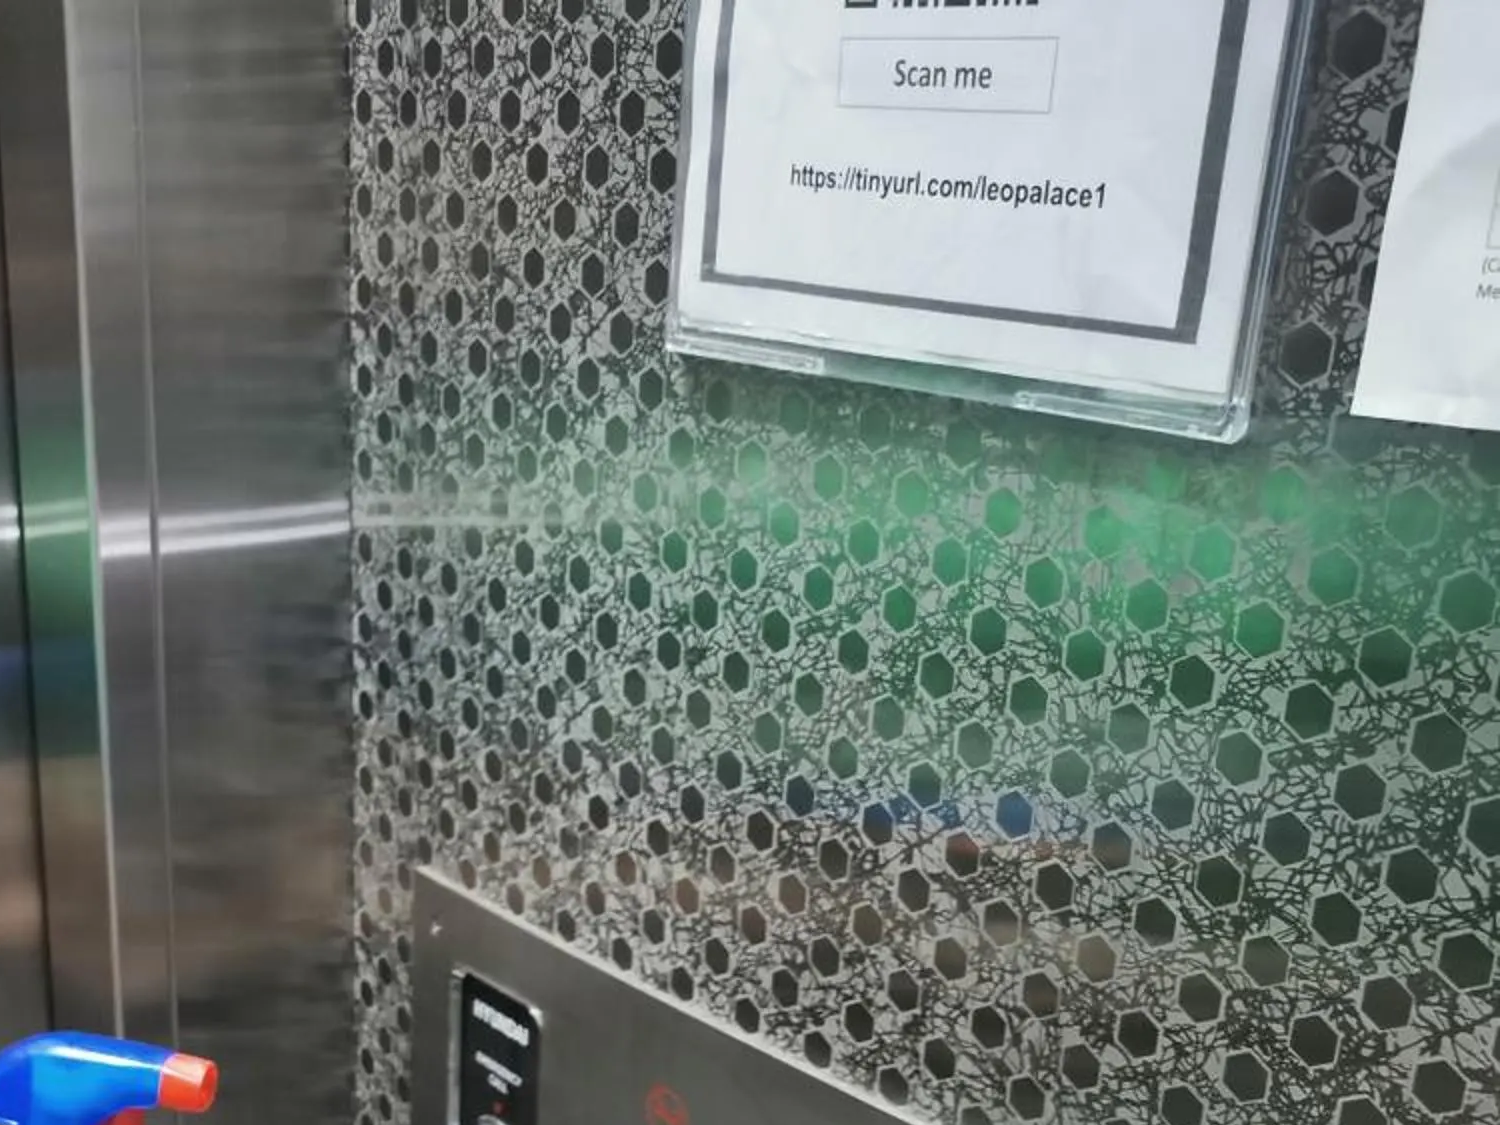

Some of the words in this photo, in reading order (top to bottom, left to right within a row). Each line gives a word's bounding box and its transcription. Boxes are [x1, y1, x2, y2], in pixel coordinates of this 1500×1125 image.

[893, 59, 947, 89] Scan
[953, 66, 993, 89] me
[789, 163, 1107, 209] https://tinyurl.com/leopalace1
